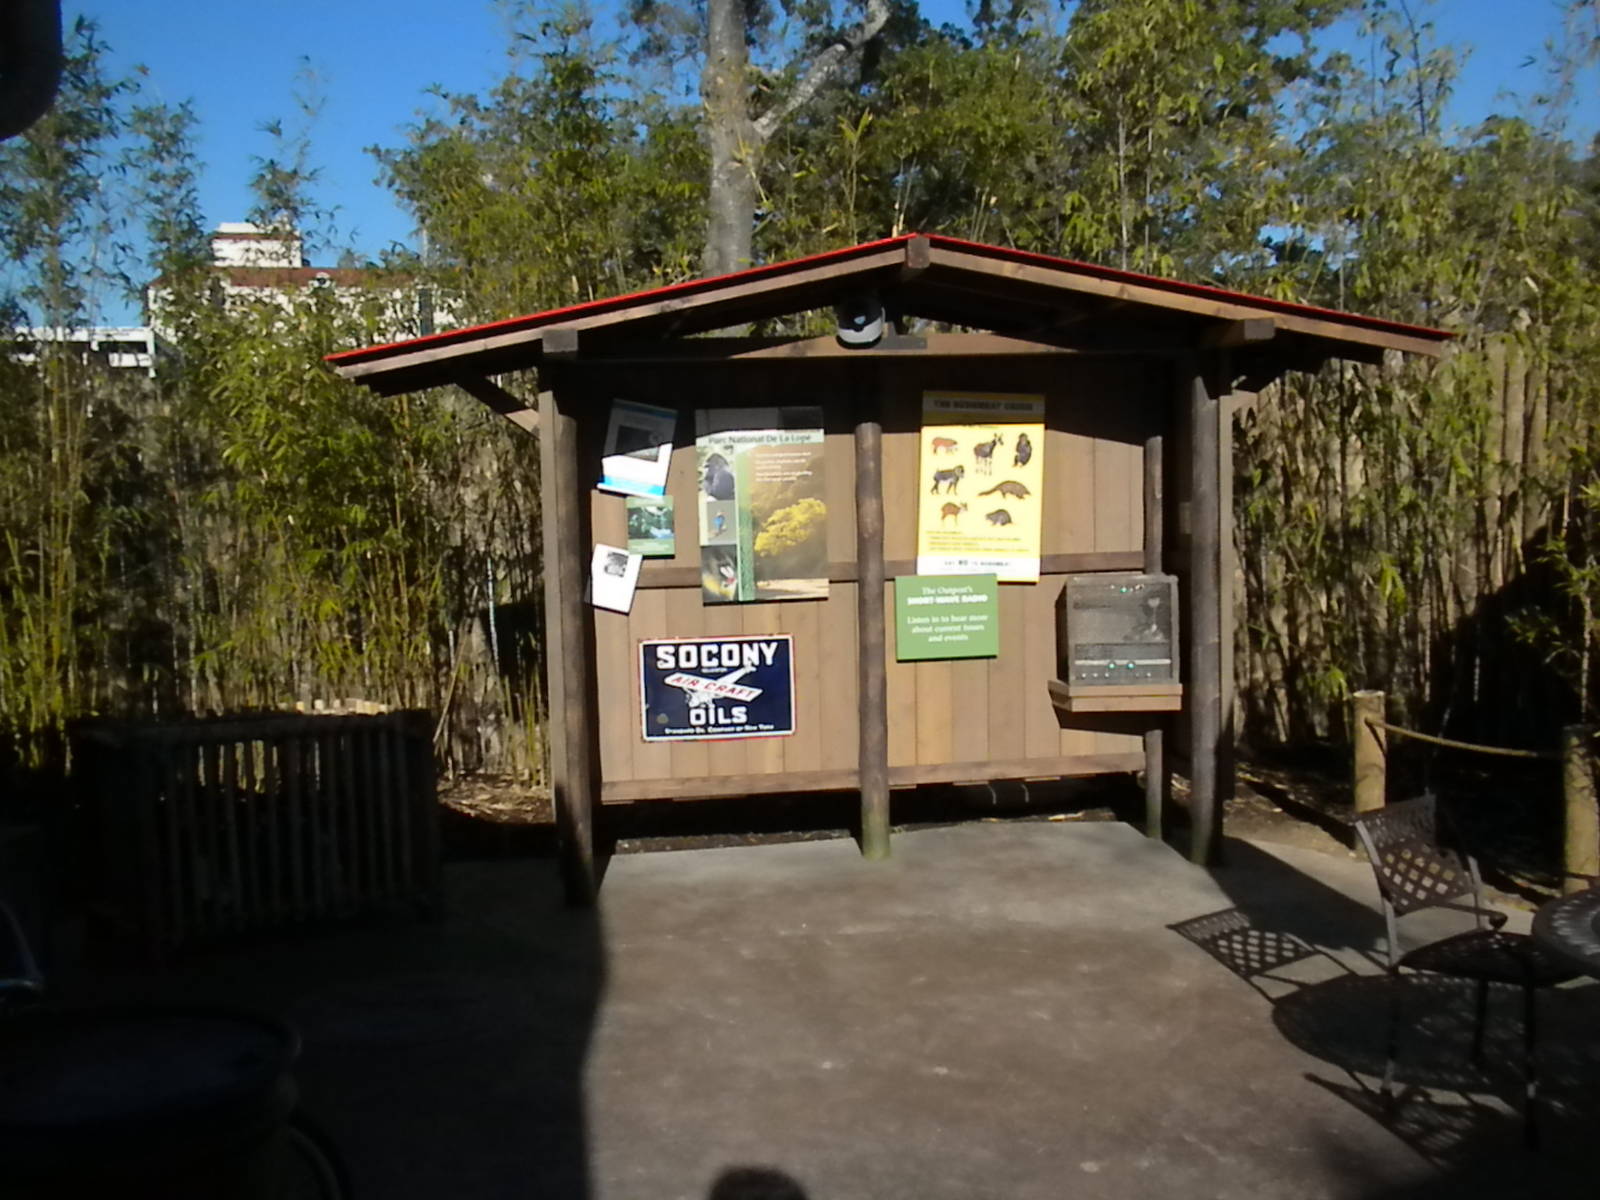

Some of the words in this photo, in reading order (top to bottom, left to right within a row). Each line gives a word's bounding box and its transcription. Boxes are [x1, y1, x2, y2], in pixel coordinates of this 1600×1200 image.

[708, 436, 726, 444] Parc
[729, 435, 764, 444] National
[766, 435, 778, 443] De
[780, 434, 790, 443] La
[921, 587, 937, 595] The
[907, 615, 930, 625] Listen
[950, 613, 967, 623] hear
[911, 625, 933, 635] about
[928, 634, 943, 643] and
[656, 642, 778, 669] SOCONY
[671, 675, 698, 688] AIR
[703, 681, 757, 699] CRAFT
[689, 706, 748, 725] OILS
